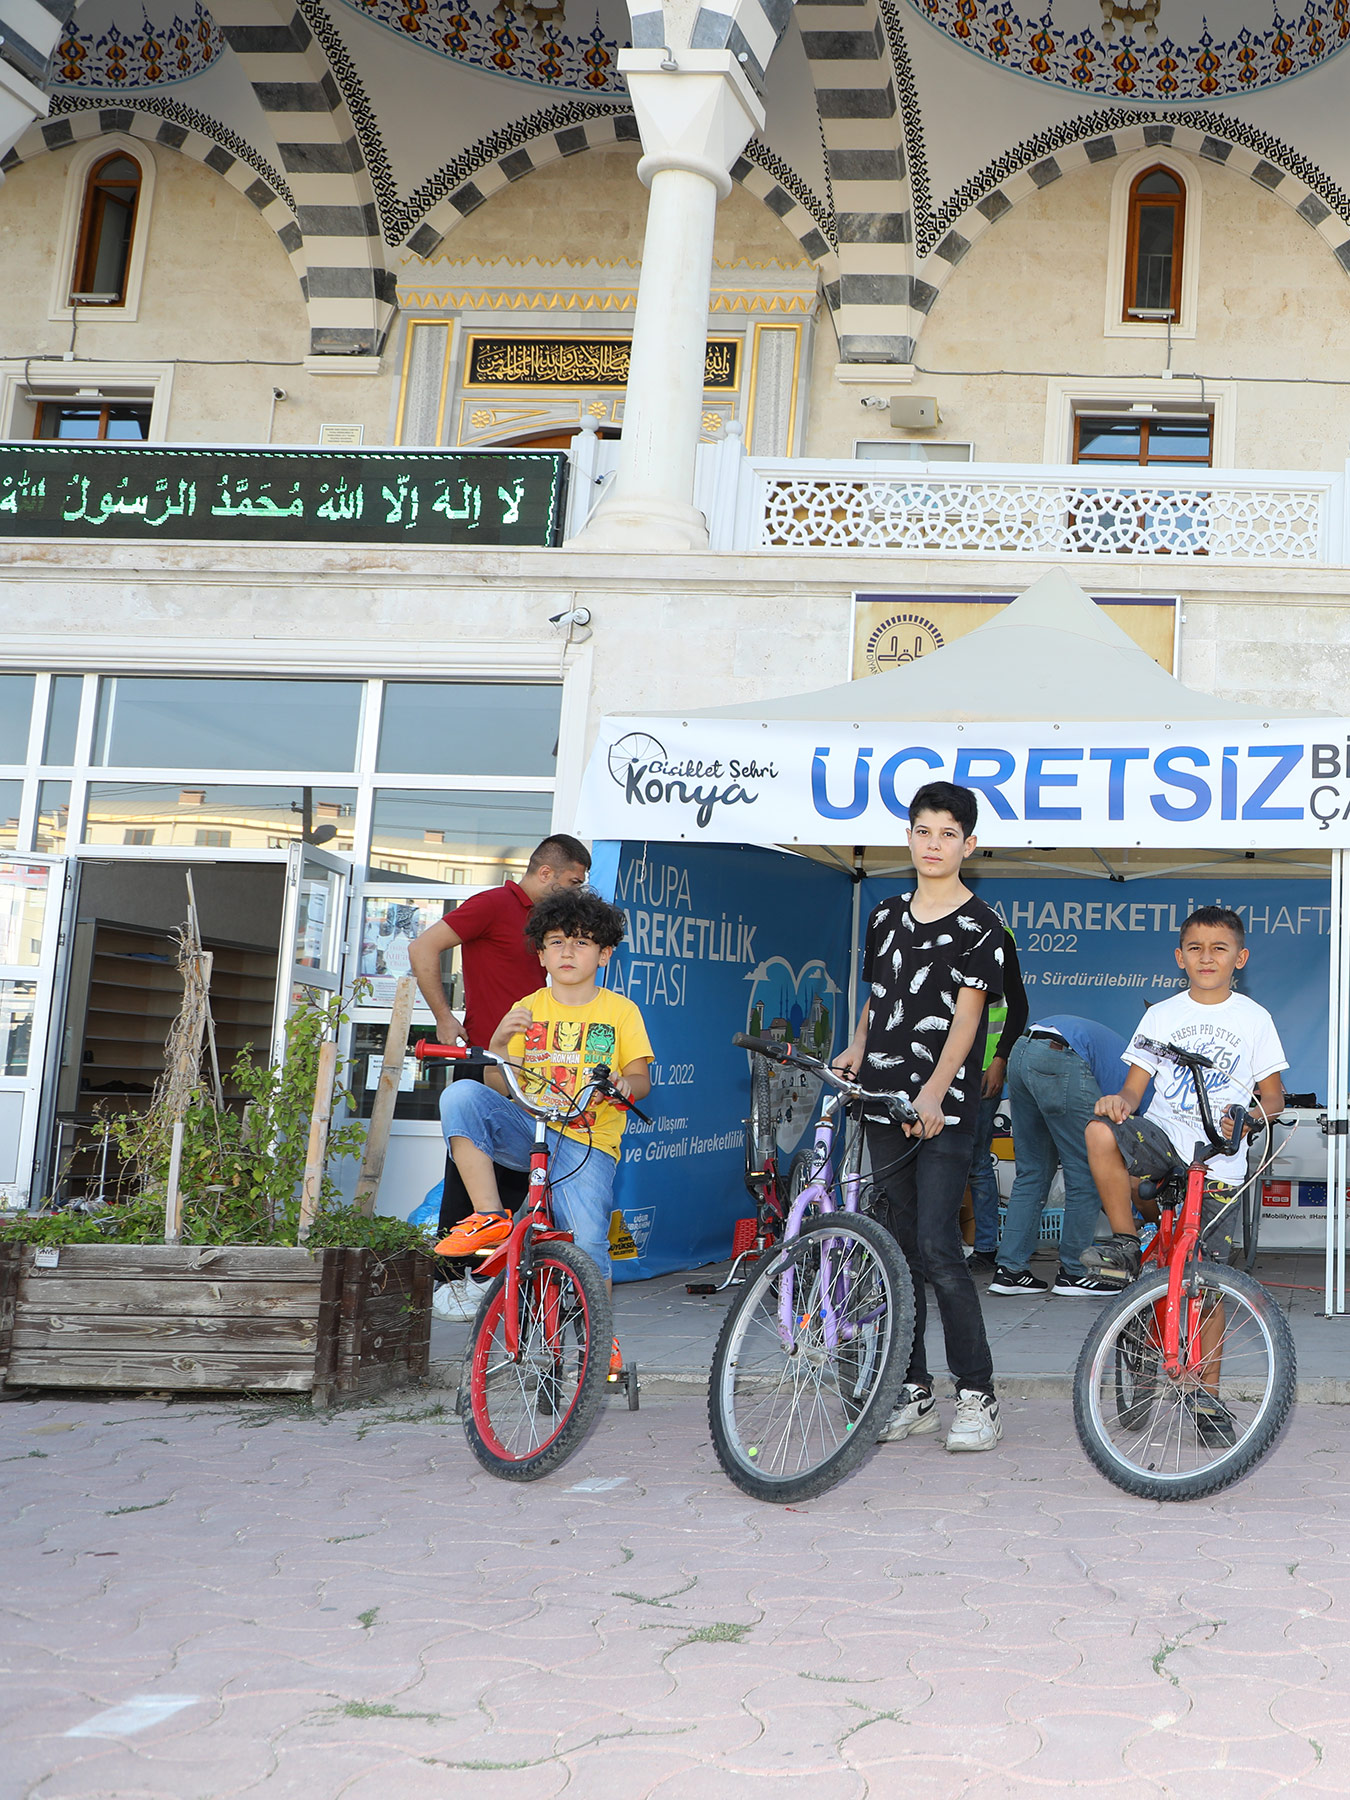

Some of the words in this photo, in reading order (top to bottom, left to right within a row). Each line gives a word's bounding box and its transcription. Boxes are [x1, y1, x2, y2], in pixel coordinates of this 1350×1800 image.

[648, 758, 725, 776] Bisiklet
[730, 758, 779, 782] Şehri
[625, 763, 759, 828] Konya
[811, 745, 1306, 822] ÜCRETSİZ
[616, 858, 692, 911] VRUPA
[614, 908, 757, 964] AREKETLİLİK
[1028, 933, 1078, 953] 2022
[1041, 971, 1149, 988] Sürdürülebilir
[1171, 1025, 1197, 1043] FRESH
[1215, 1027, 1242, 1048] STYLE
[585, 1053, 612, 1065] HULK
[1213, 1045, 1233, 1070] 75
[668, 1063, 695, 1086] 2022
[658, 1116, 689, 1134] Ulaşım:
[625, 1149, 641, 1163] ve
[646, 1136, 688, 1161] Güvenli
[690, 1130, 745, 1155] Hareketlilik
